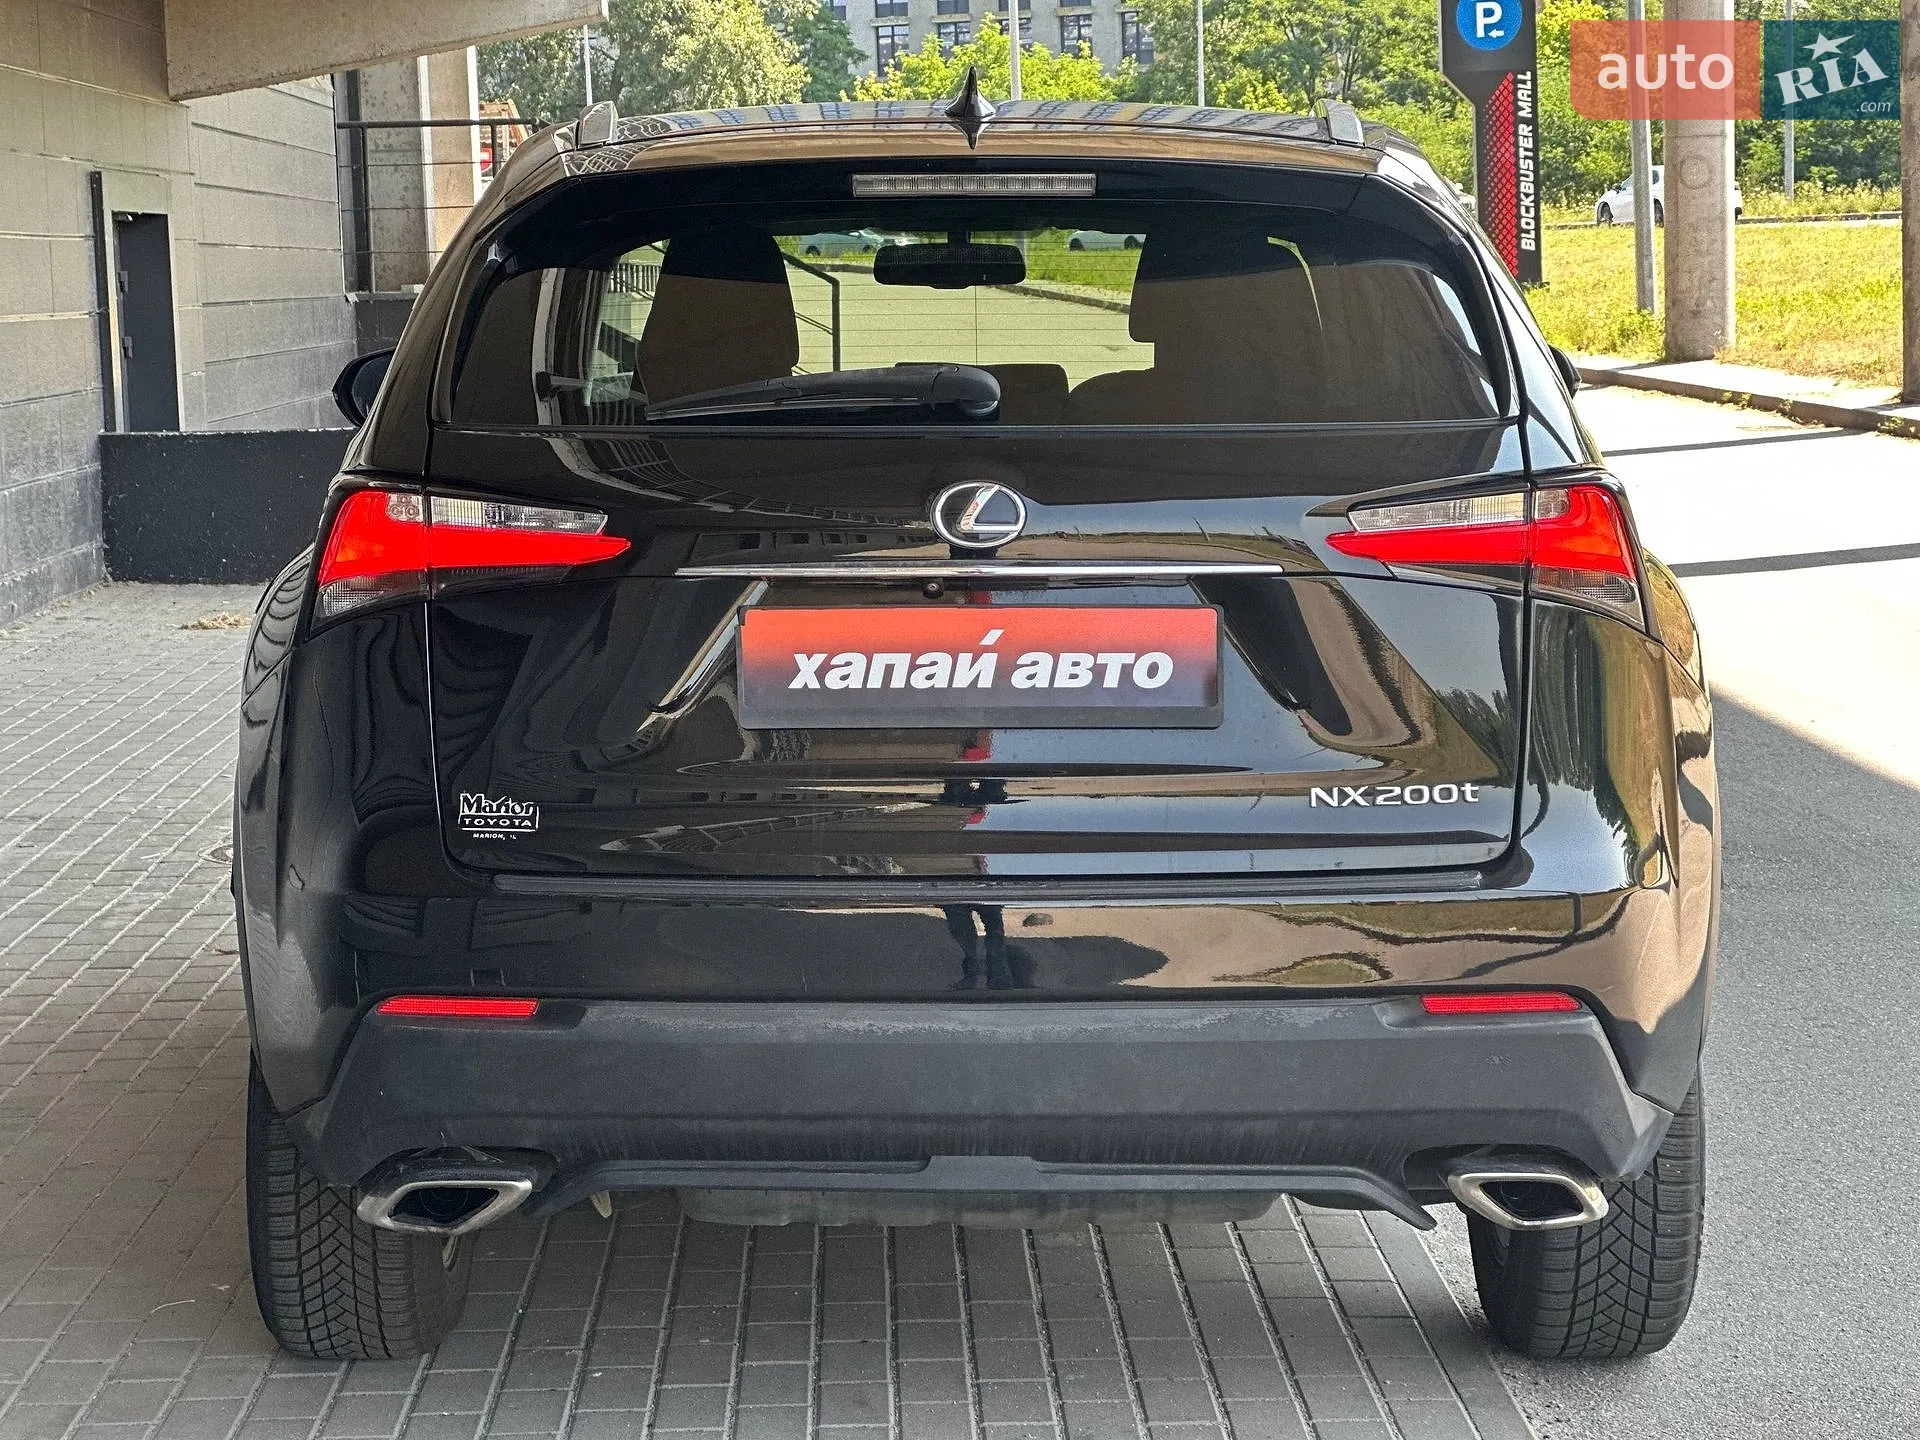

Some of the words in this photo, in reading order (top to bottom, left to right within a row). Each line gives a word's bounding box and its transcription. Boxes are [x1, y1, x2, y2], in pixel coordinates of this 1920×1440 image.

[1475, 1, 1503, 38] P
[1517, 70, 1532, 118] MALL
[1518, 124, 1536, 251] BLOCKBUSTER
[1011, 651, 1174, 689] авто
[1310, 782, 1480, 808] NX200t
[463, 818, 532, 827] TOYOTA
